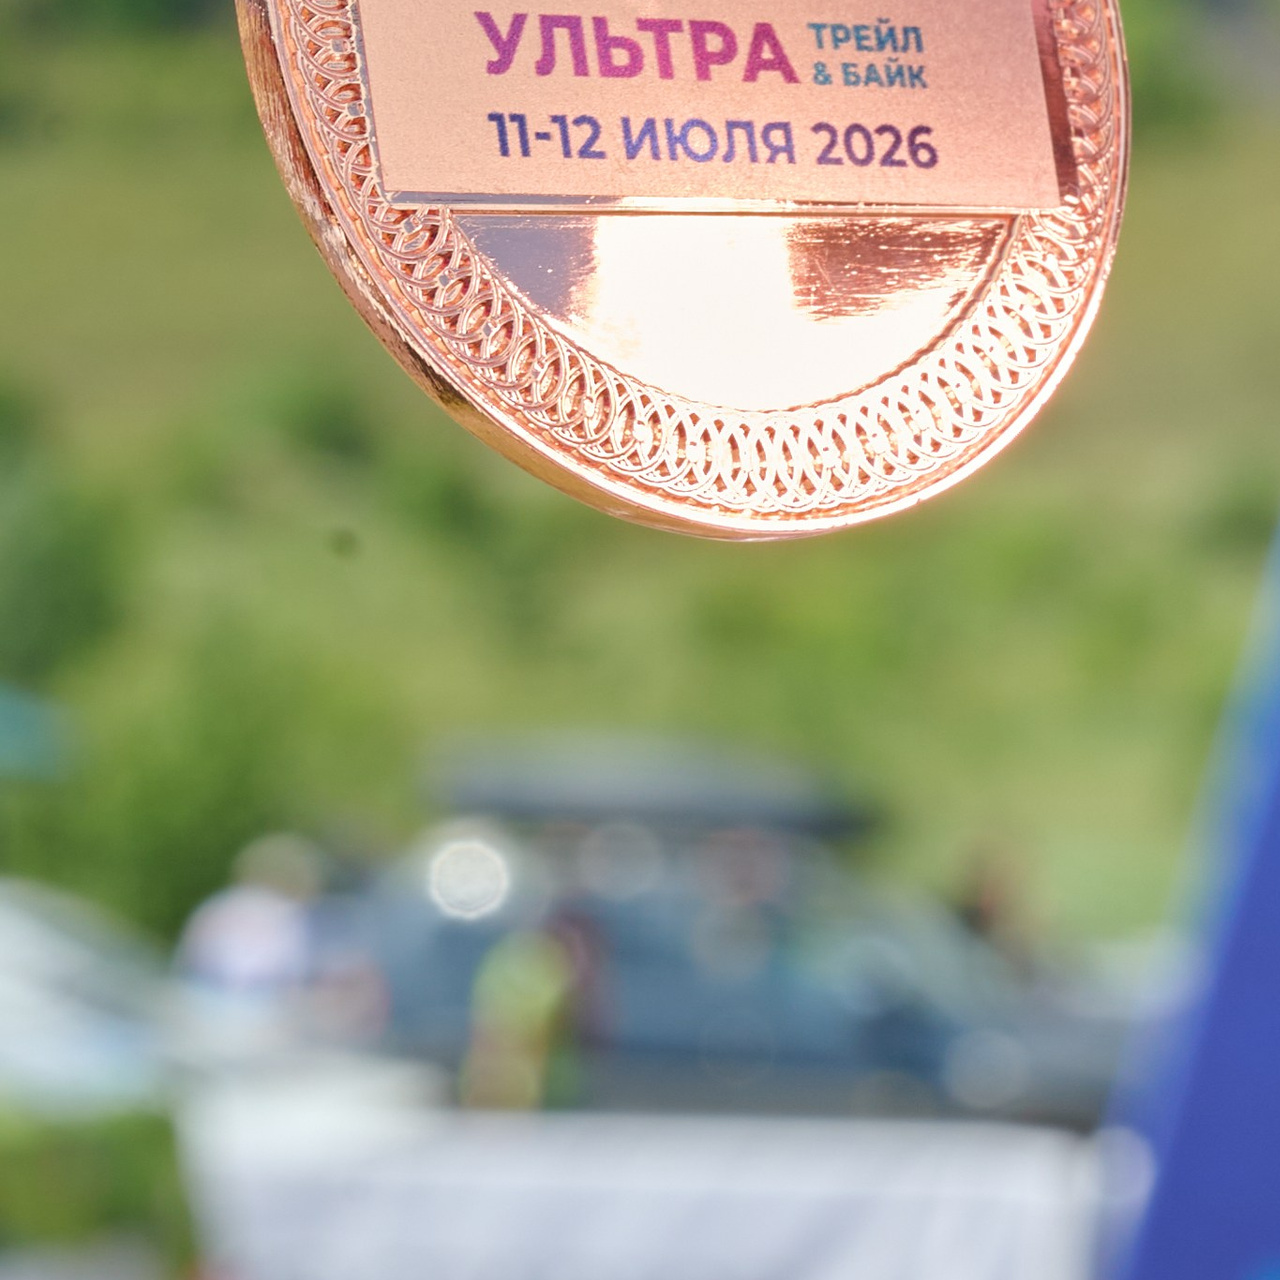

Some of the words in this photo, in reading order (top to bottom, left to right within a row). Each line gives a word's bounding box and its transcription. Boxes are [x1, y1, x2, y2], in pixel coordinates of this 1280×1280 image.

[473, 11, 800, 85] УЛЬТРА
[807, 17, 924, 54] ТРЕЙЛ
[812, 61, 834, 86] &
[841, 57, 928, 90] БАЙК
[487, 112, 606, 160] 11-12
[620, 116, 796, 165] ИЮЛЯ
[811, 122, 938, 170] 2026
